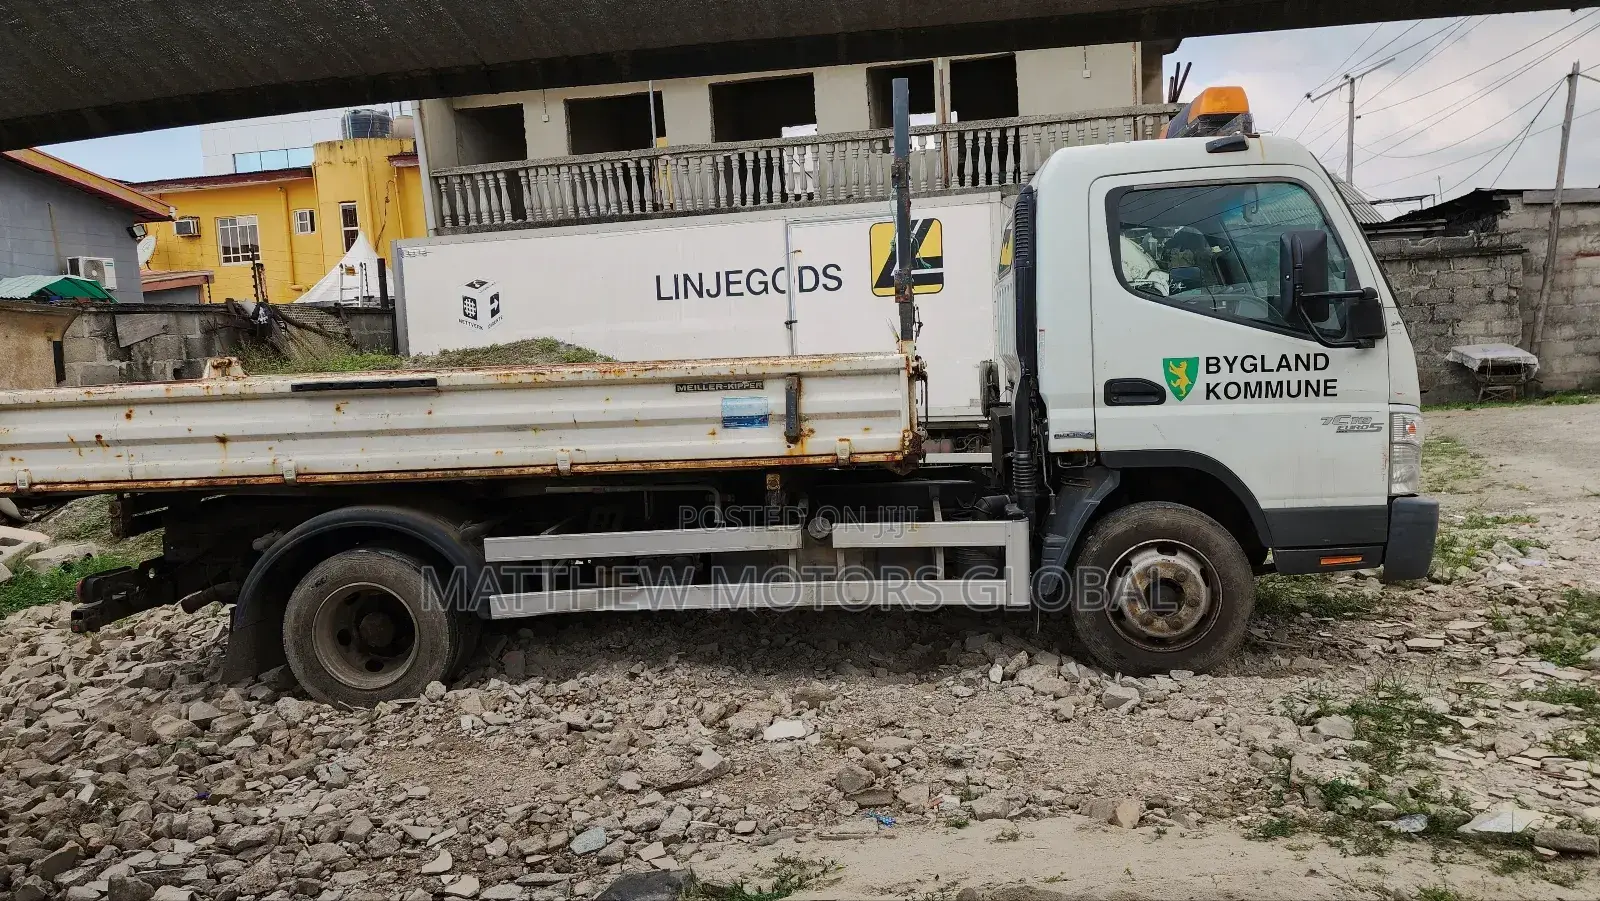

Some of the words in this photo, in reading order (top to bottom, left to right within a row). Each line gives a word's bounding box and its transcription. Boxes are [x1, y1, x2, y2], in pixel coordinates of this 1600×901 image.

[1205, 353, 1330, 374] BYGLAND
[676, 381, 763, 392] MEILLER-KIPPER
[1205, 379, 1338, 400] KOMMUNE
